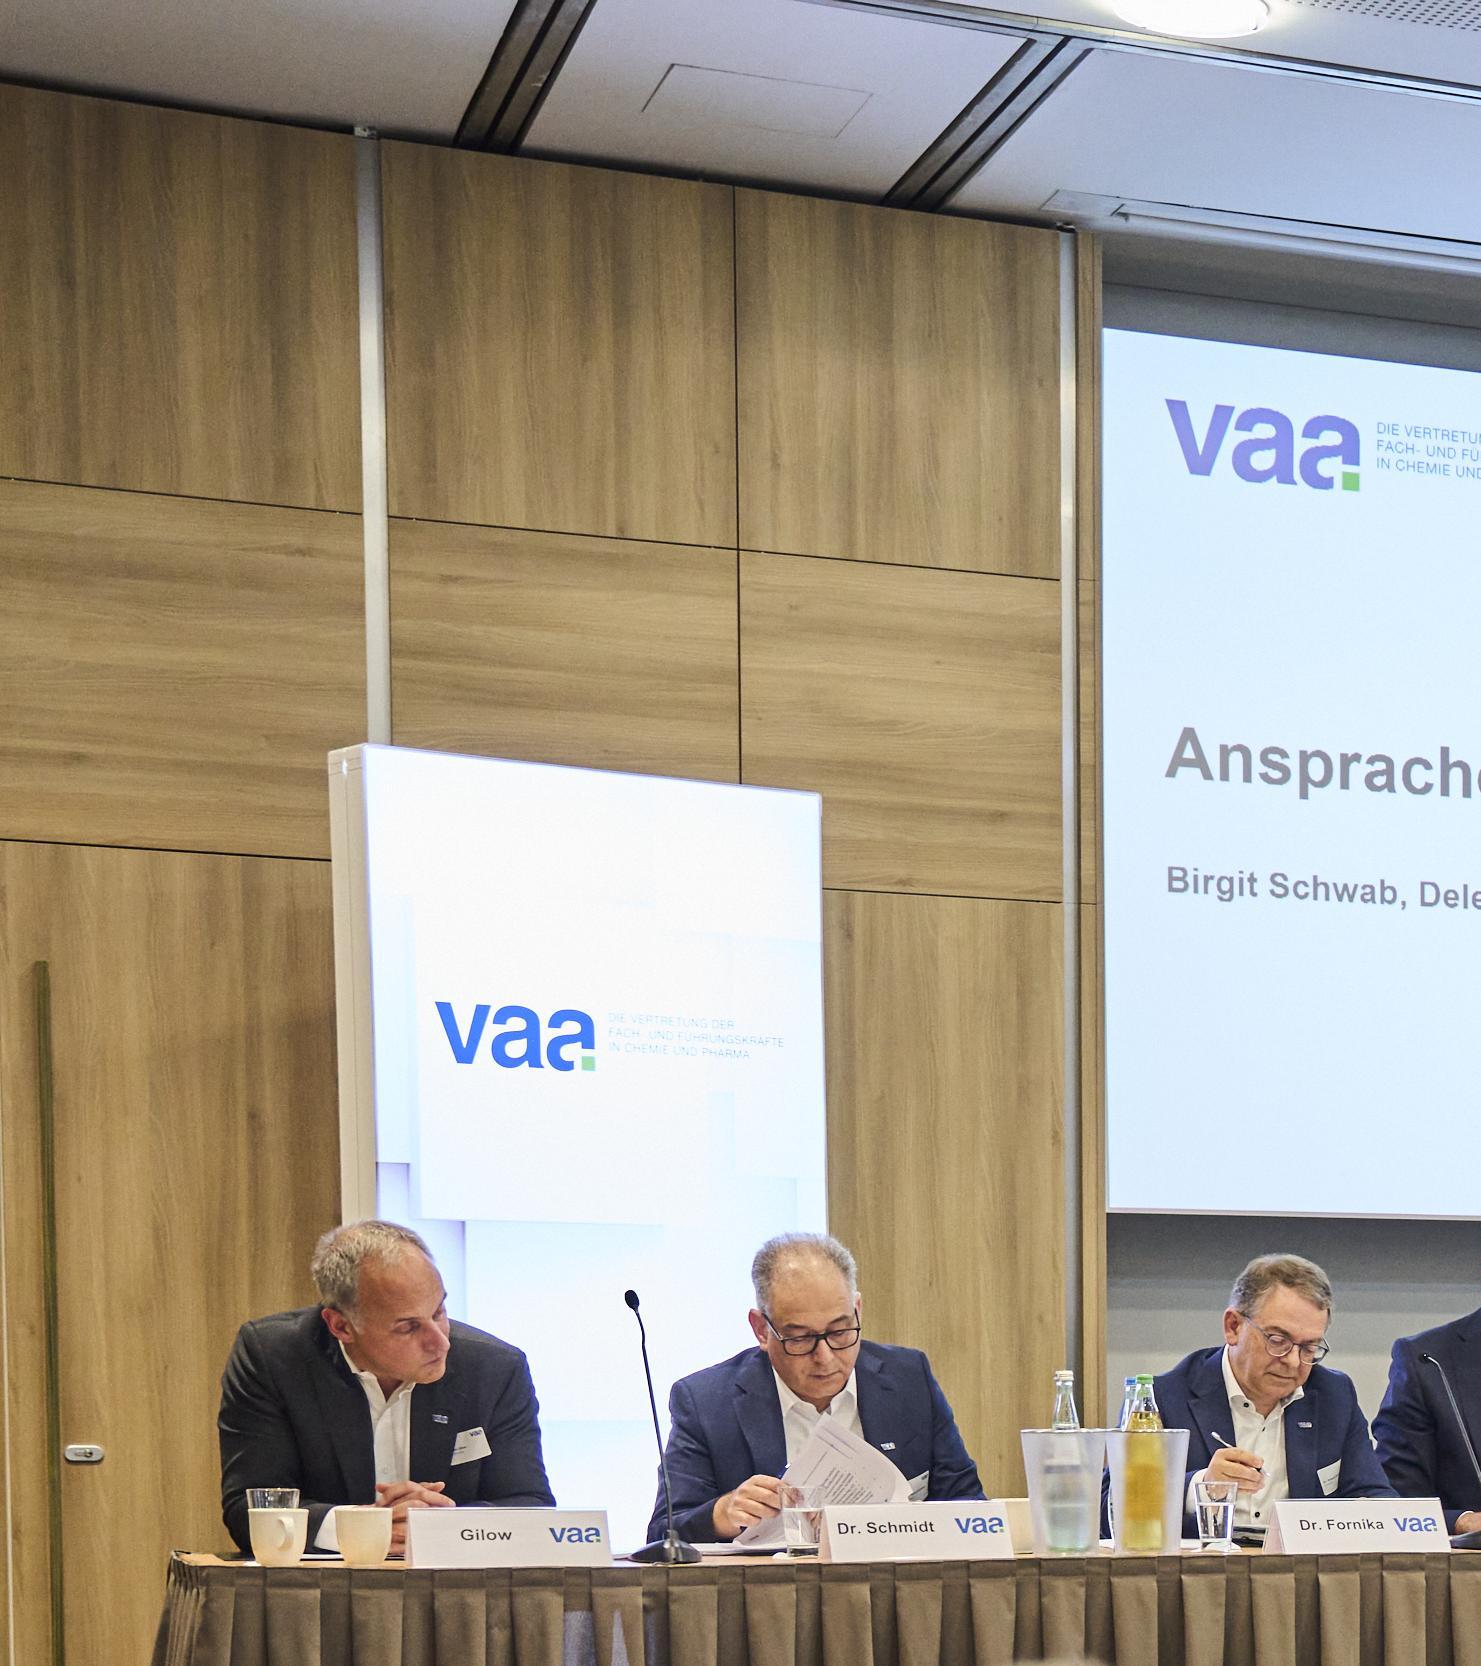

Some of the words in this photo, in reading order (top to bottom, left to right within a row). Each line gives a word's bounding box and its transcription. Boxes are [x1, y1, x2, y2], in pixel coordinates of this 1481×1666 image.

[1376, 421, 1400, 436] DIE
[1376, 439, 1421, 455] FACH-
[1427, 445, 1457, 460] UND
[1376, 456, 1391, 470] IN
[1395, 458, 1452, 477] CHEMIE
[1167, 866, 1258, 903] Birgit
[1268, 872, 1407, 911] Schwab,
[607, 1012, 625, 1024] DIE
[630, 1014, 708, 1028] VERTRETUNG
[711, 1018, 737, 1030] DER
[647, 1029, 674, 1041] UND
[607, 1042, 621, 1053] IN
[624, 1044, 669, 1056] CHEMIE
[673, 1046, 698, 1057] UND
[702, 1048, 751, 1060] PHARMA
[837, 1522, 862, 1535] Dr.
[866, 1520, 935, 1534] Schmidt
[1299, 1519, 1322, 1531] Dr.
[1326, 1518, 1385, 1531] Fornika
[460, 1527, 512, 1541] Gilow
